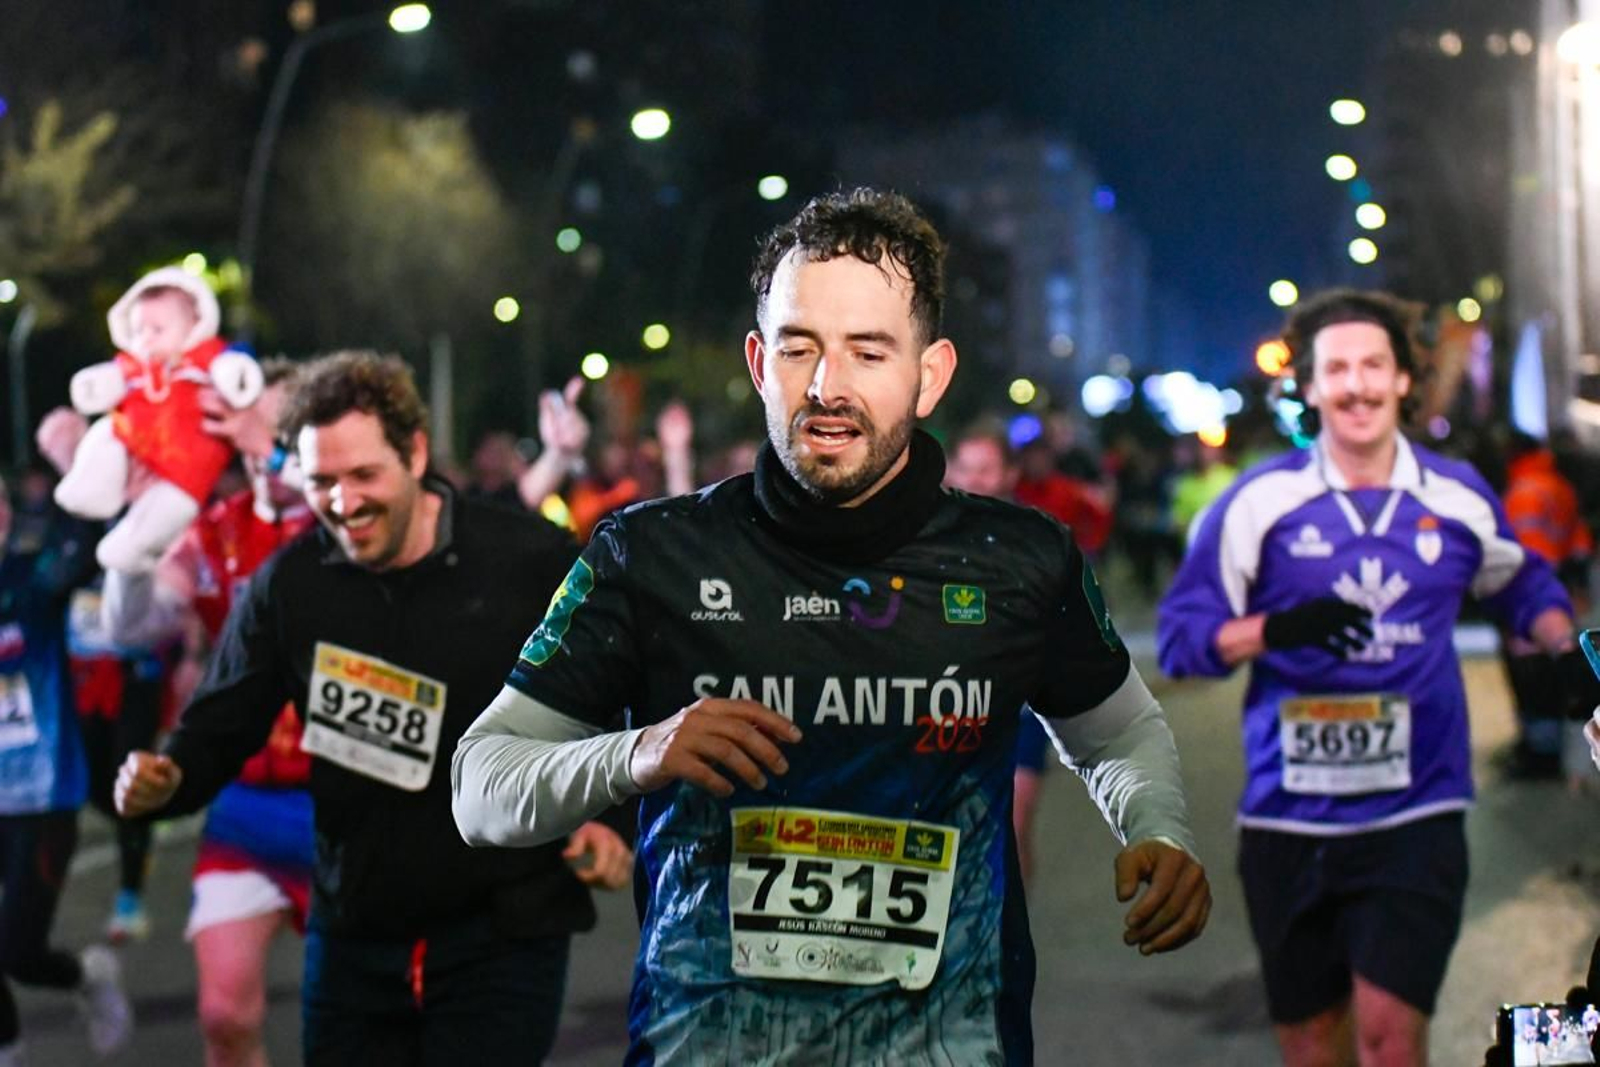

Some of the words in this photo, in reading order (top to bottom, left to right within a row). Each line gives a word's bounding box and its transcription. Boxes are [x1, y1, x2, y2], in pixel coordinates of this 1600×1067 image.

[321, 681, 427, 745] 9258
[813, 665, 992, 726] ANTÓN
[1295, 719, 1395, 758] 5697
[748, 858, 929, 926] 7515
